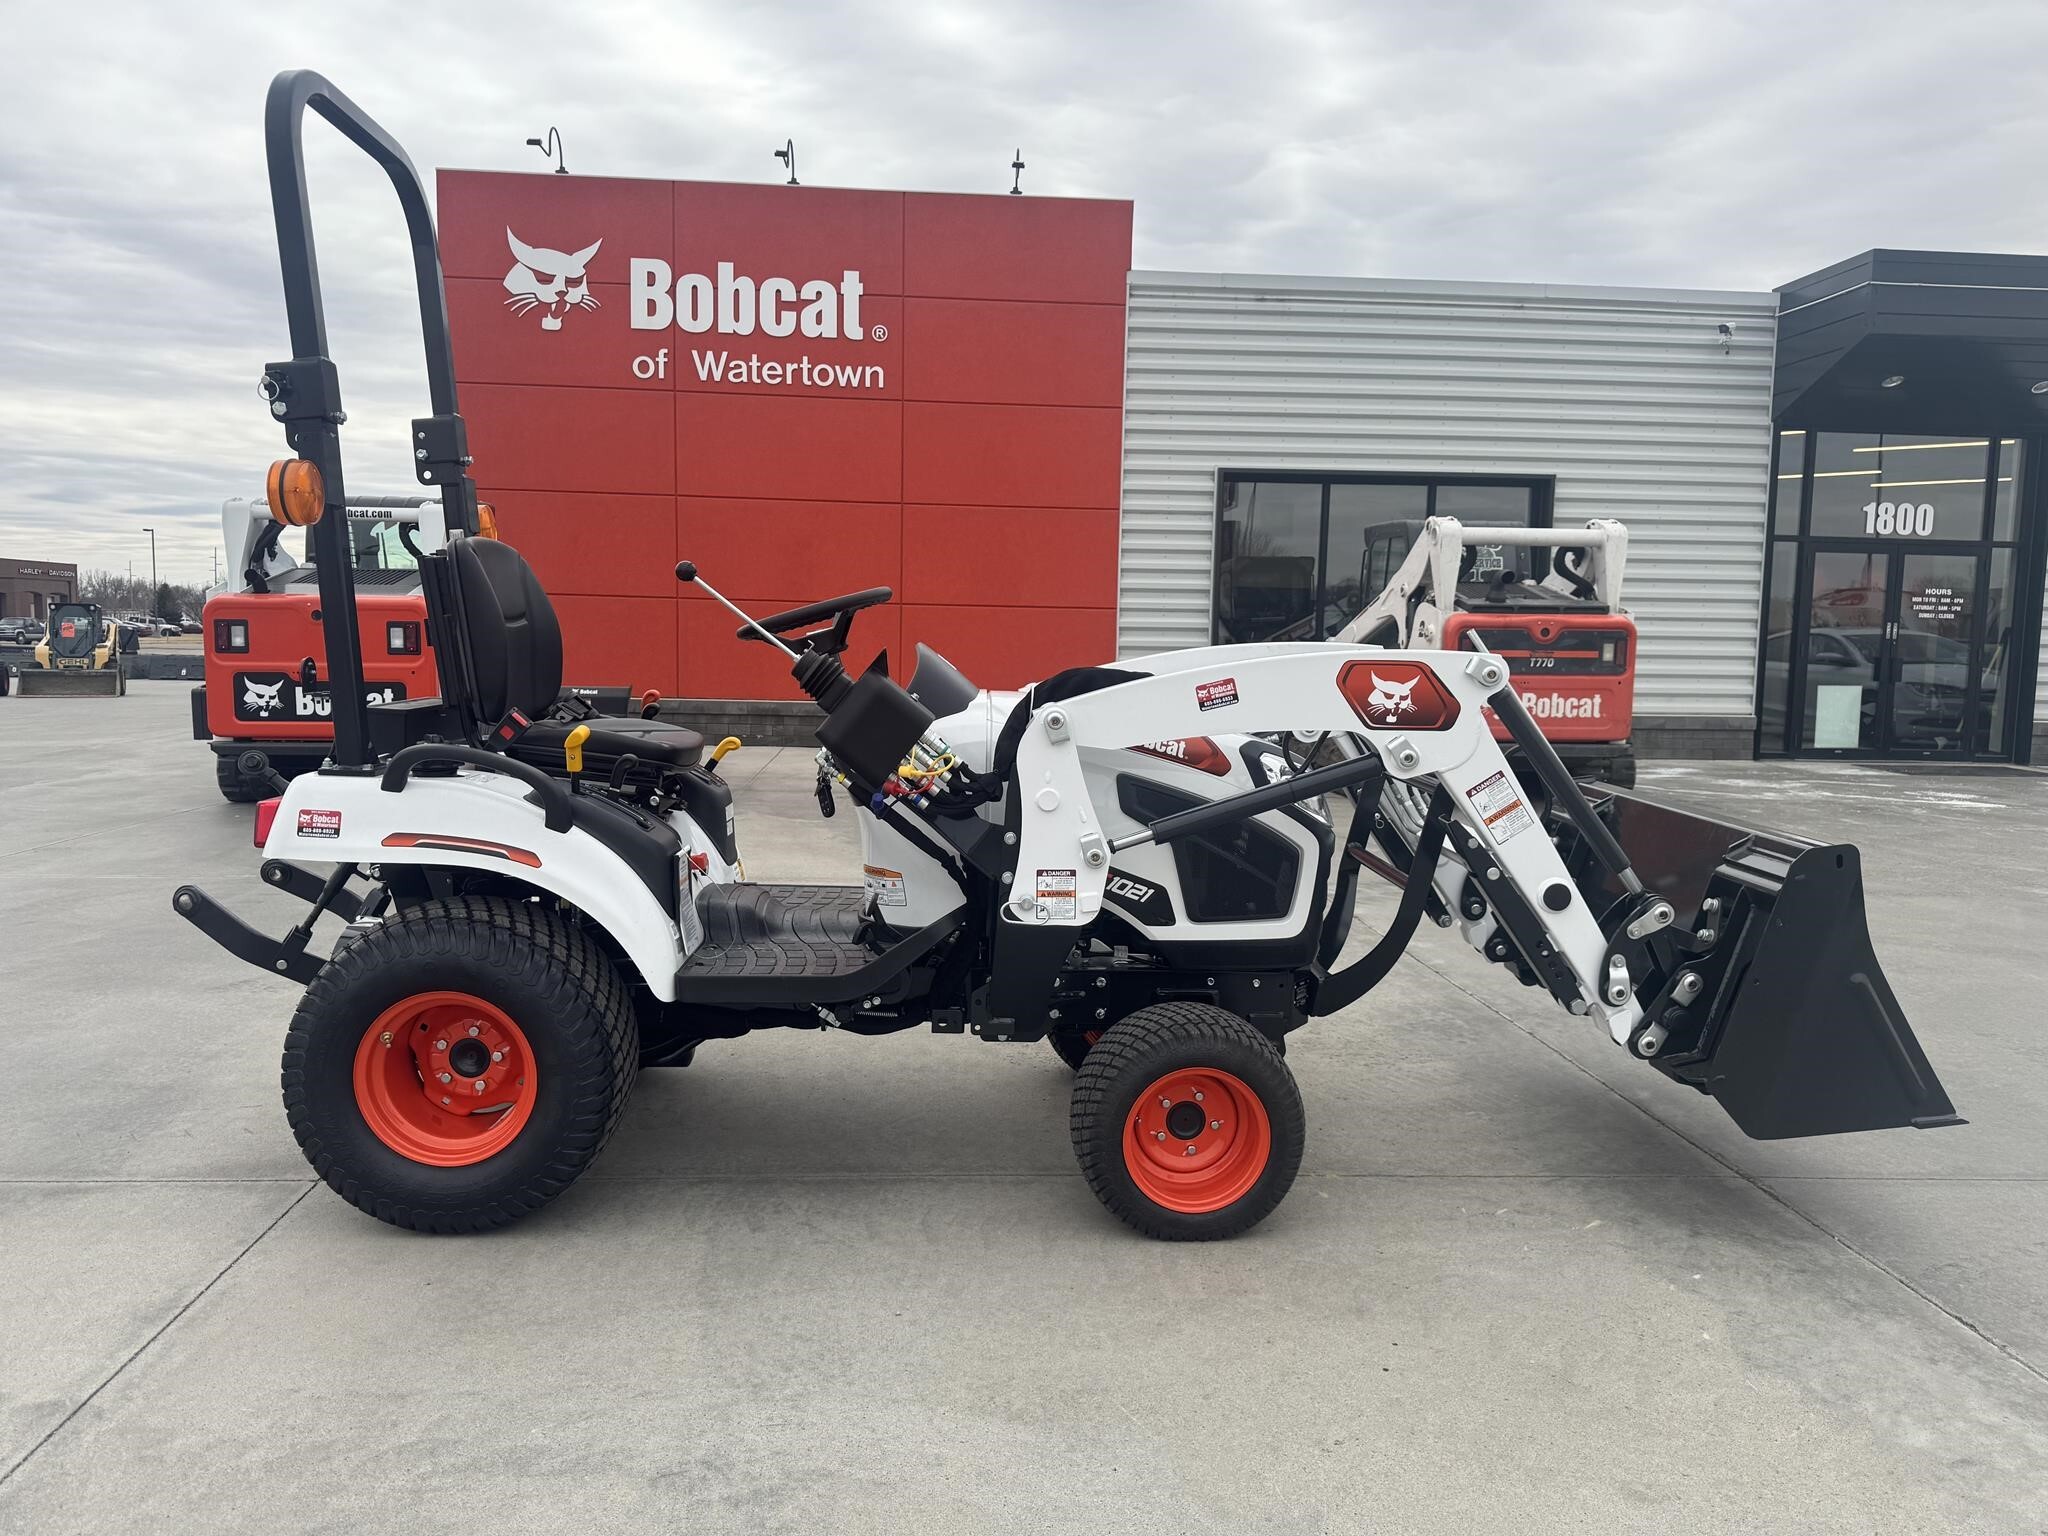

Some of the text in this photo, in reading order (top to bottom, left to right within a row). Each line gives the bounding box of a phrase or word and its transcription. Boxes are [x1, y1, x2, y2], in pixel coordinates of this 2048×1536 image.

[630, 257, 863, 341] Bobcat
[632, 349, 884, 389] of Watertown
[347, 509, 392, 518] bcat.com
[1862, 502, 1934, 536] 1800
[49, 569, 75, 577] DAVIDSON
[1529, 658, 1555, 668] T770
[1210, 683, 1235, 695] Bobcat
[295, 686, 394, 716] Boat
[1522, 692, 1602, 718] Bobcat
[1476, 773, 1501, 791] DANGER
[312, 814, 339, 824] Bobcat
[1494, 802, 1519, 820] WARNING
[1105, 876, 1155, 903] 1021
